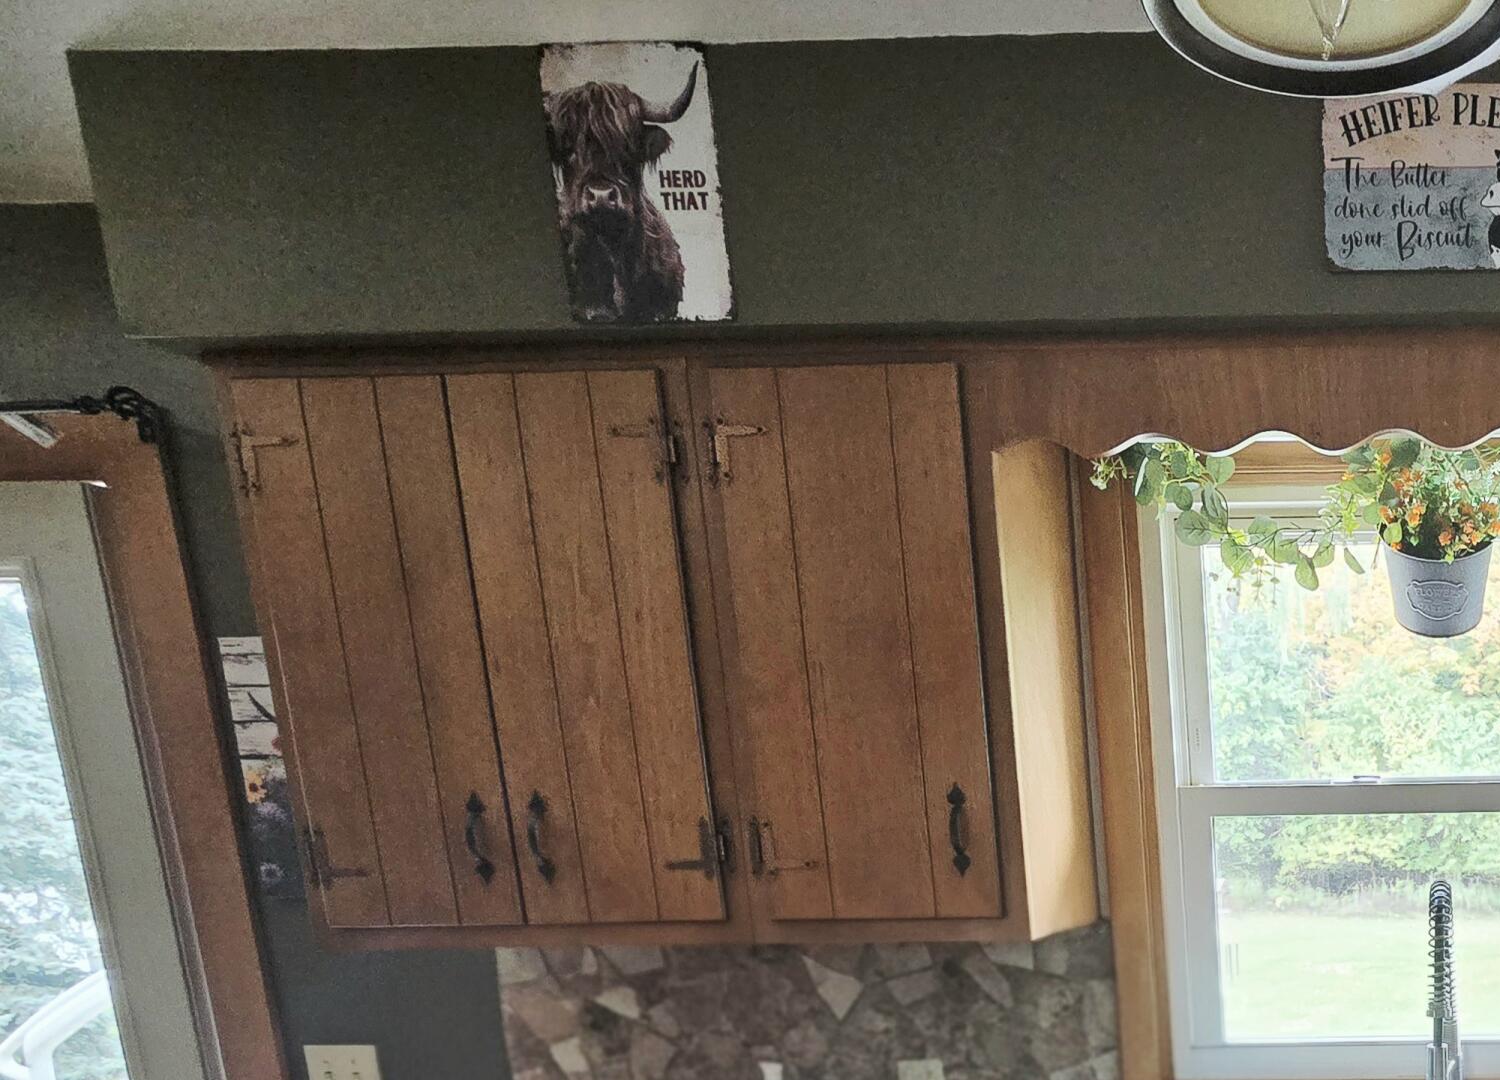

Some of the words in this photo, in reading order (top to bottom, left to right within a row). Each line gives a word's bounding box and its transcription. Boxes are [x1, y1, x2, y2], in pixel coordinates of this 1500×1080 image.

[1339, 94, 1441, 147] HEIFER
[659, 170, 706, 188] HERD
[1330, 157, 1382, 193] The
[1390, 159, 1450, 190] Butter
[660, 191, 709, 211] THAT
[1334, 195, 1384, 219] done
[1391, 194, 1431, 219] slid
[1438, 196, 1468, 222] off
[1339, 230, 1383, 259] your
[1396, 220, 1474, 261] Biscuit
